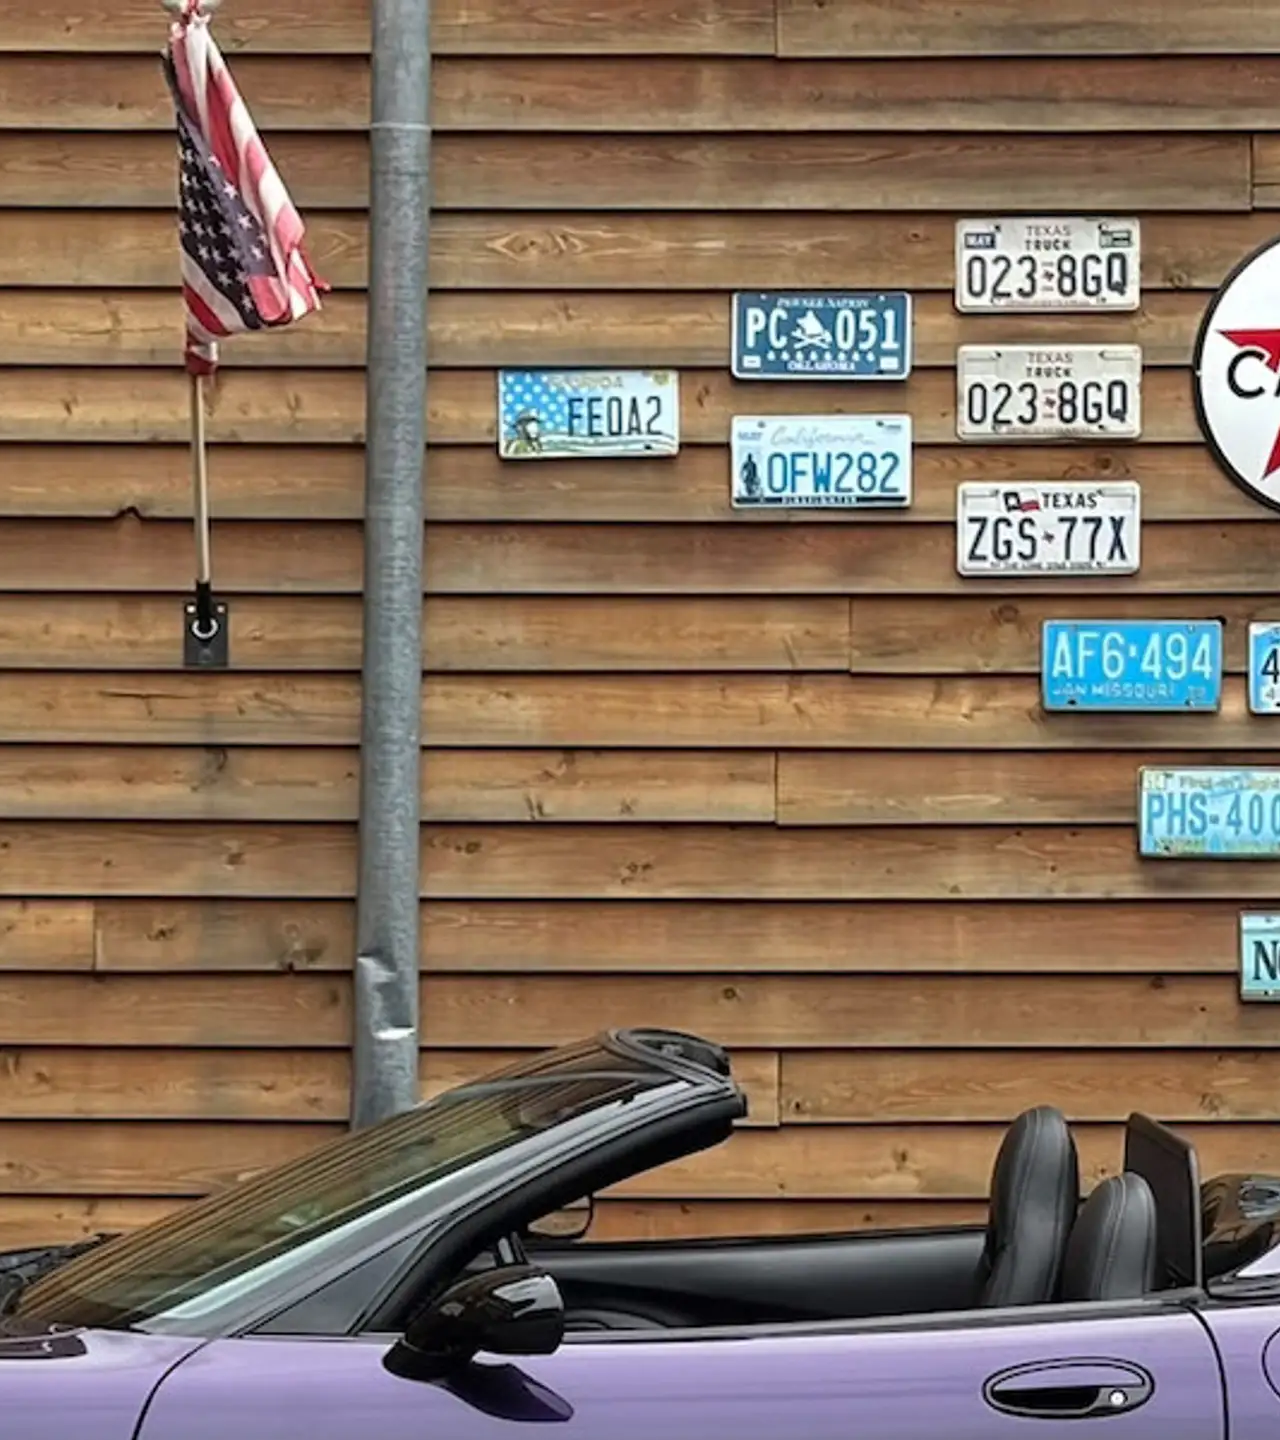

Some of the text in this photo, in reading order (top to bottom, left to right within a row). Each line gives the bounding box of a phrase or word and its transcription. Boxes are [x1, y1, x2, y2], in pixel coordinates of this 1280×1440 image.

[1026, 225, 1071, 237] TEXAS
[1024, 239, 1072, 251] TRUCK
[745, 307, 901, 351] PC 051
[1028, 351, 1074, 364] TEXAS
[1026, 366, 1074, 379] TRUCK
[1040, 491, 1099, 509] TEXAS
[1091, 683, 1175, 698] MISSOURI
